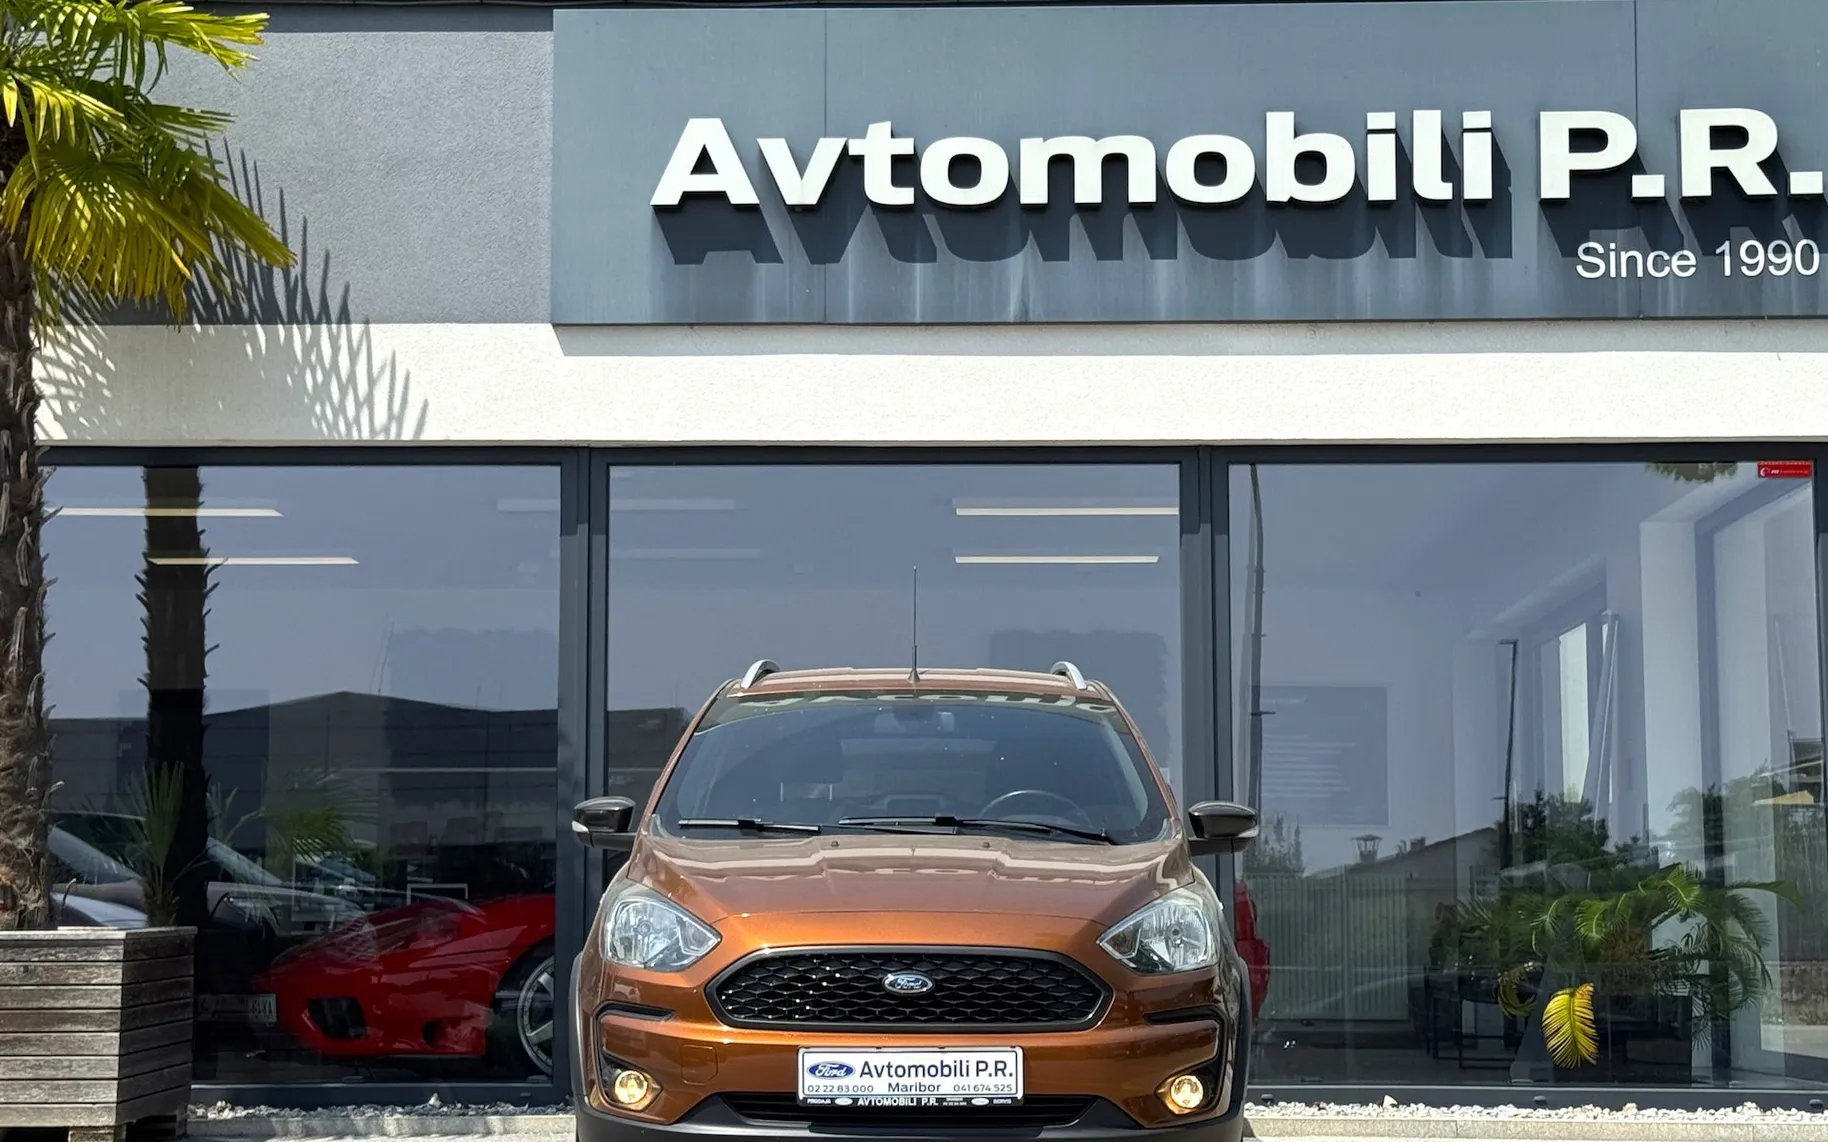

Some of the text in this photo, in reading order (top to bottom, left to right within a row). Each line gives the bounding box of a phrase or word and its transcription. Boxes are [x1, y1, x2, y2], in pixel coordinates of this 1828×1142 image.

[651, 108, 1824, 208] Avtomobili P.R.
[1576, 239, 1821, 279] Since 1990
[892, 975, 925, 990] Ford
[813, 1060, 1013, 1078] Ford Avtomobili P.R.
[807, 1081, 1013, 1093] 02 22 83 000 Maribor 041 674 525
[857, 1097, 917, 1106] AVTOMOBILI
[921, 1097, 939, 1106] P.R.
